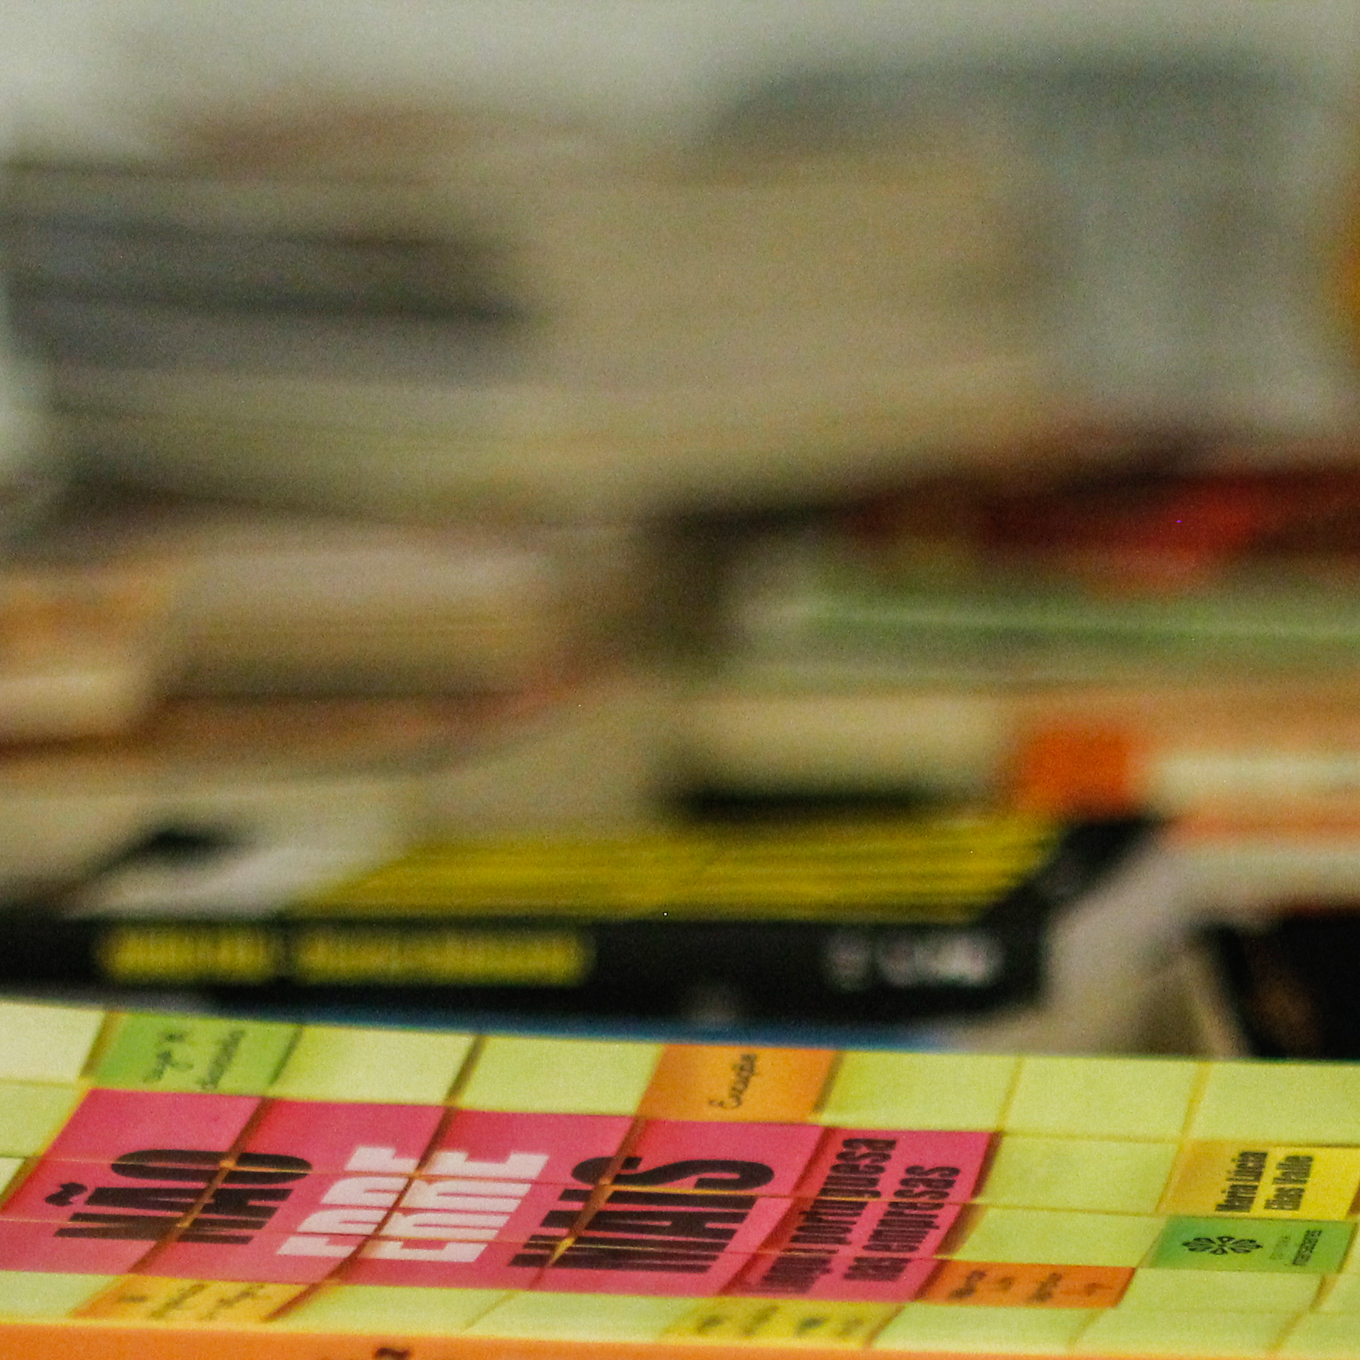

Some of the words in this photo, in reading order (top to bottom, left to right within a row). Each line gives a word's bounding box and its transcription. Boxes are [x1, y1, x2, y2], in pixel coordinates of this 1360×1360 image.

[42, 1149, 314, 1246] NÃO
[276, 1145, 550, 1264] ERRE
[508, 1155, 775, 1274] MAIS
[790, 1138, 897, 1246] portuguesa
[861, 1165, 961, 1253] empresas
[1215, 1183, 1259, 1212] Maria
[1264, 1187, 1306, 1211] Elias
[1272, 1155, 1314, 1185] Valle
